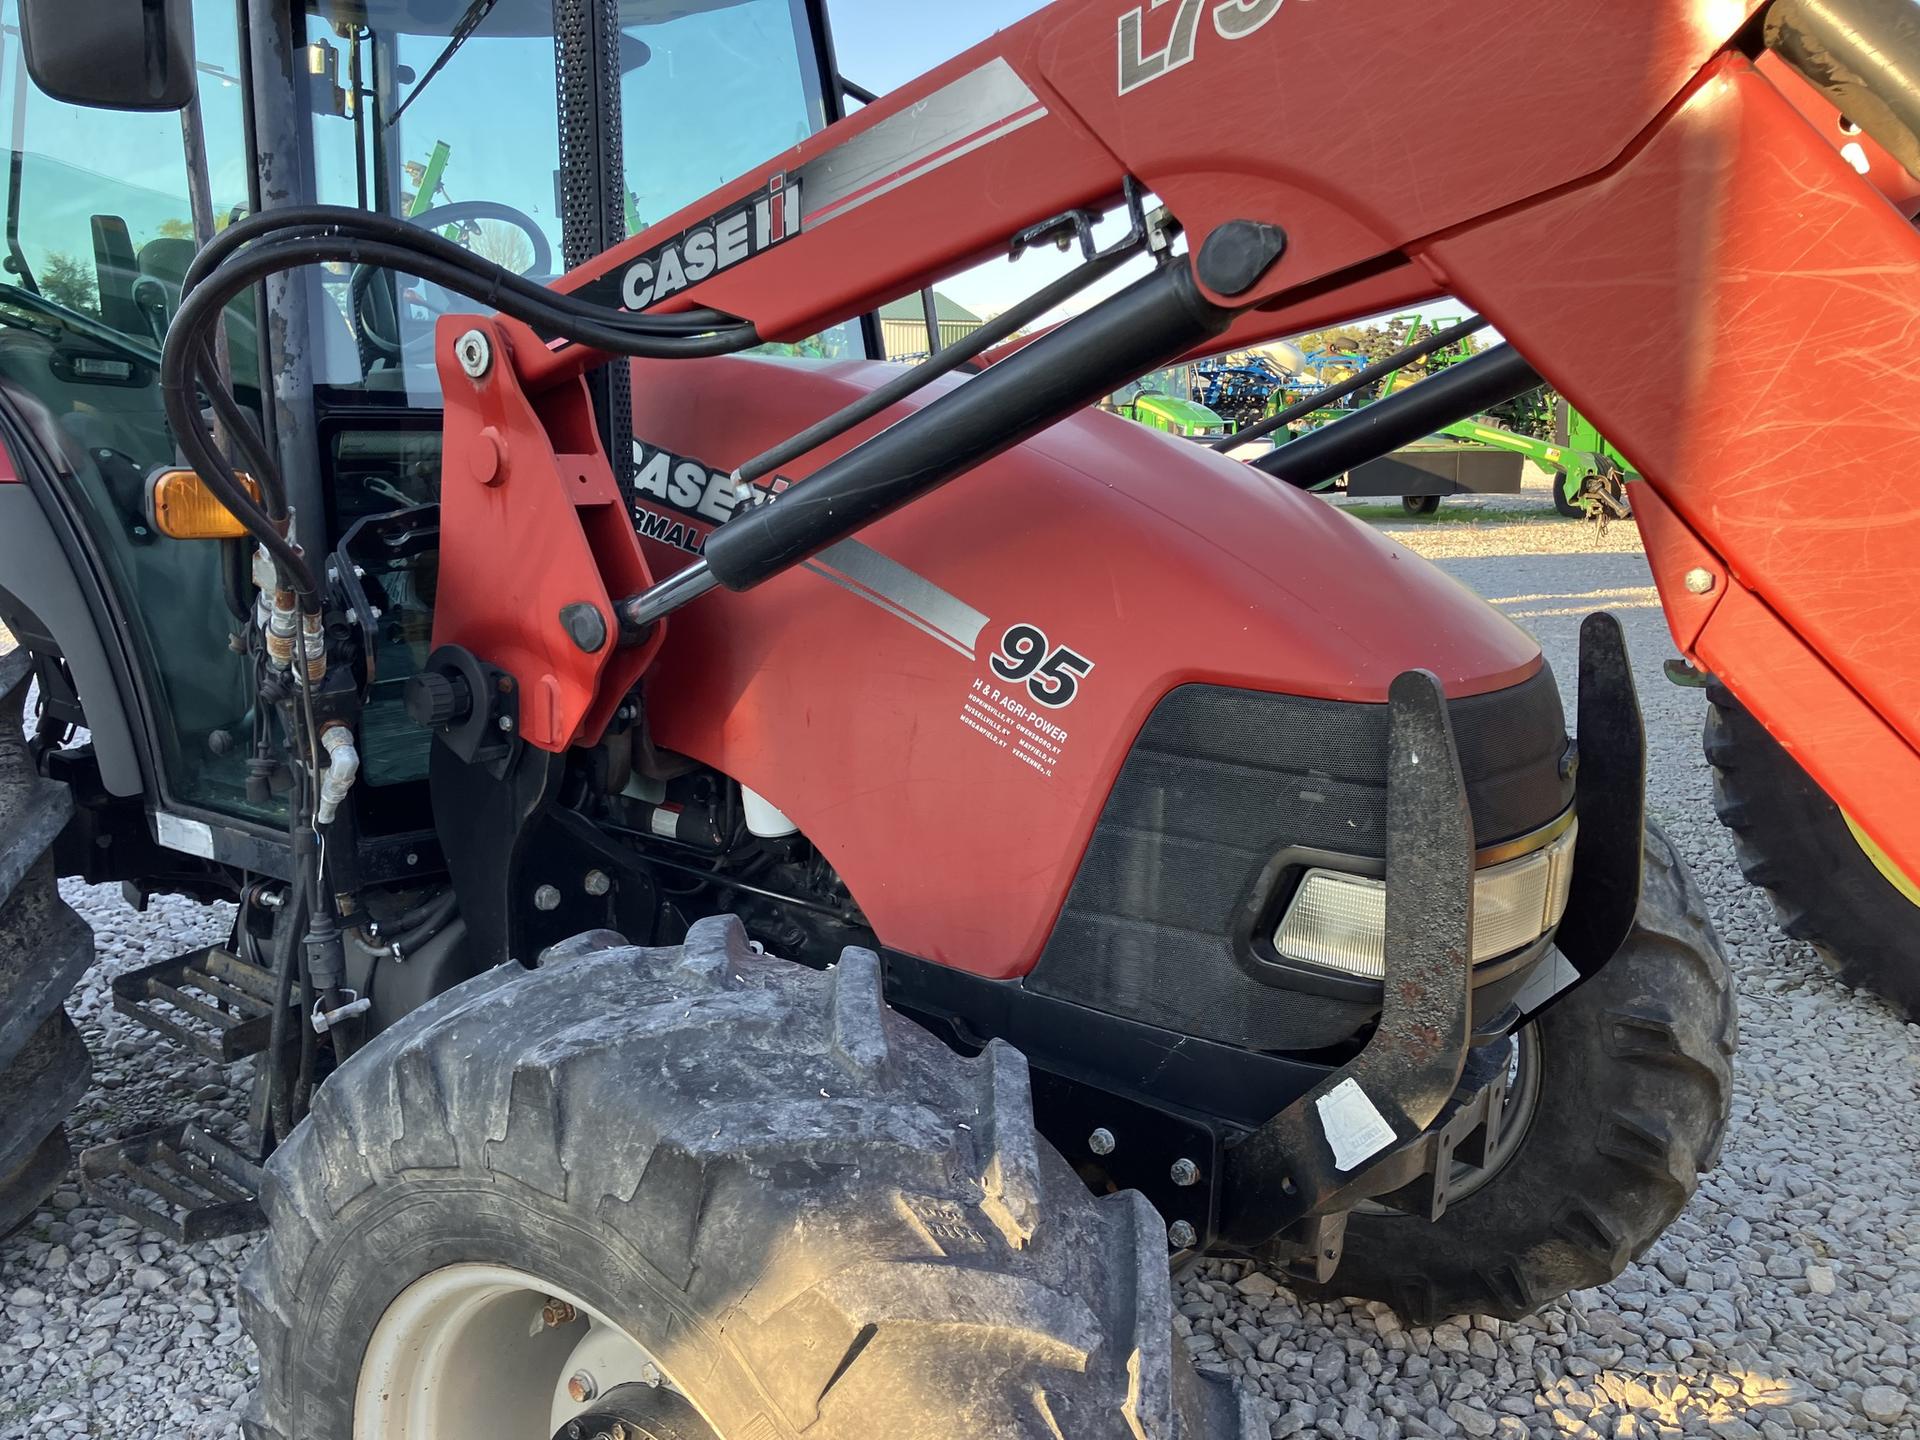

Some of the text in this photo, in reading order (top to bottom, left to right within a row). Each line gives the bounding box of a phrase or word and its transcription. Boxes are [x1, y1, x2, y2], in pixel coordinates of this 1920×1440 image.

[622, 210, 749, 311] CASE
[989, 623, 1096, 709] 95
[972, 678, 1068, 744] H & R AGRI-POWER
